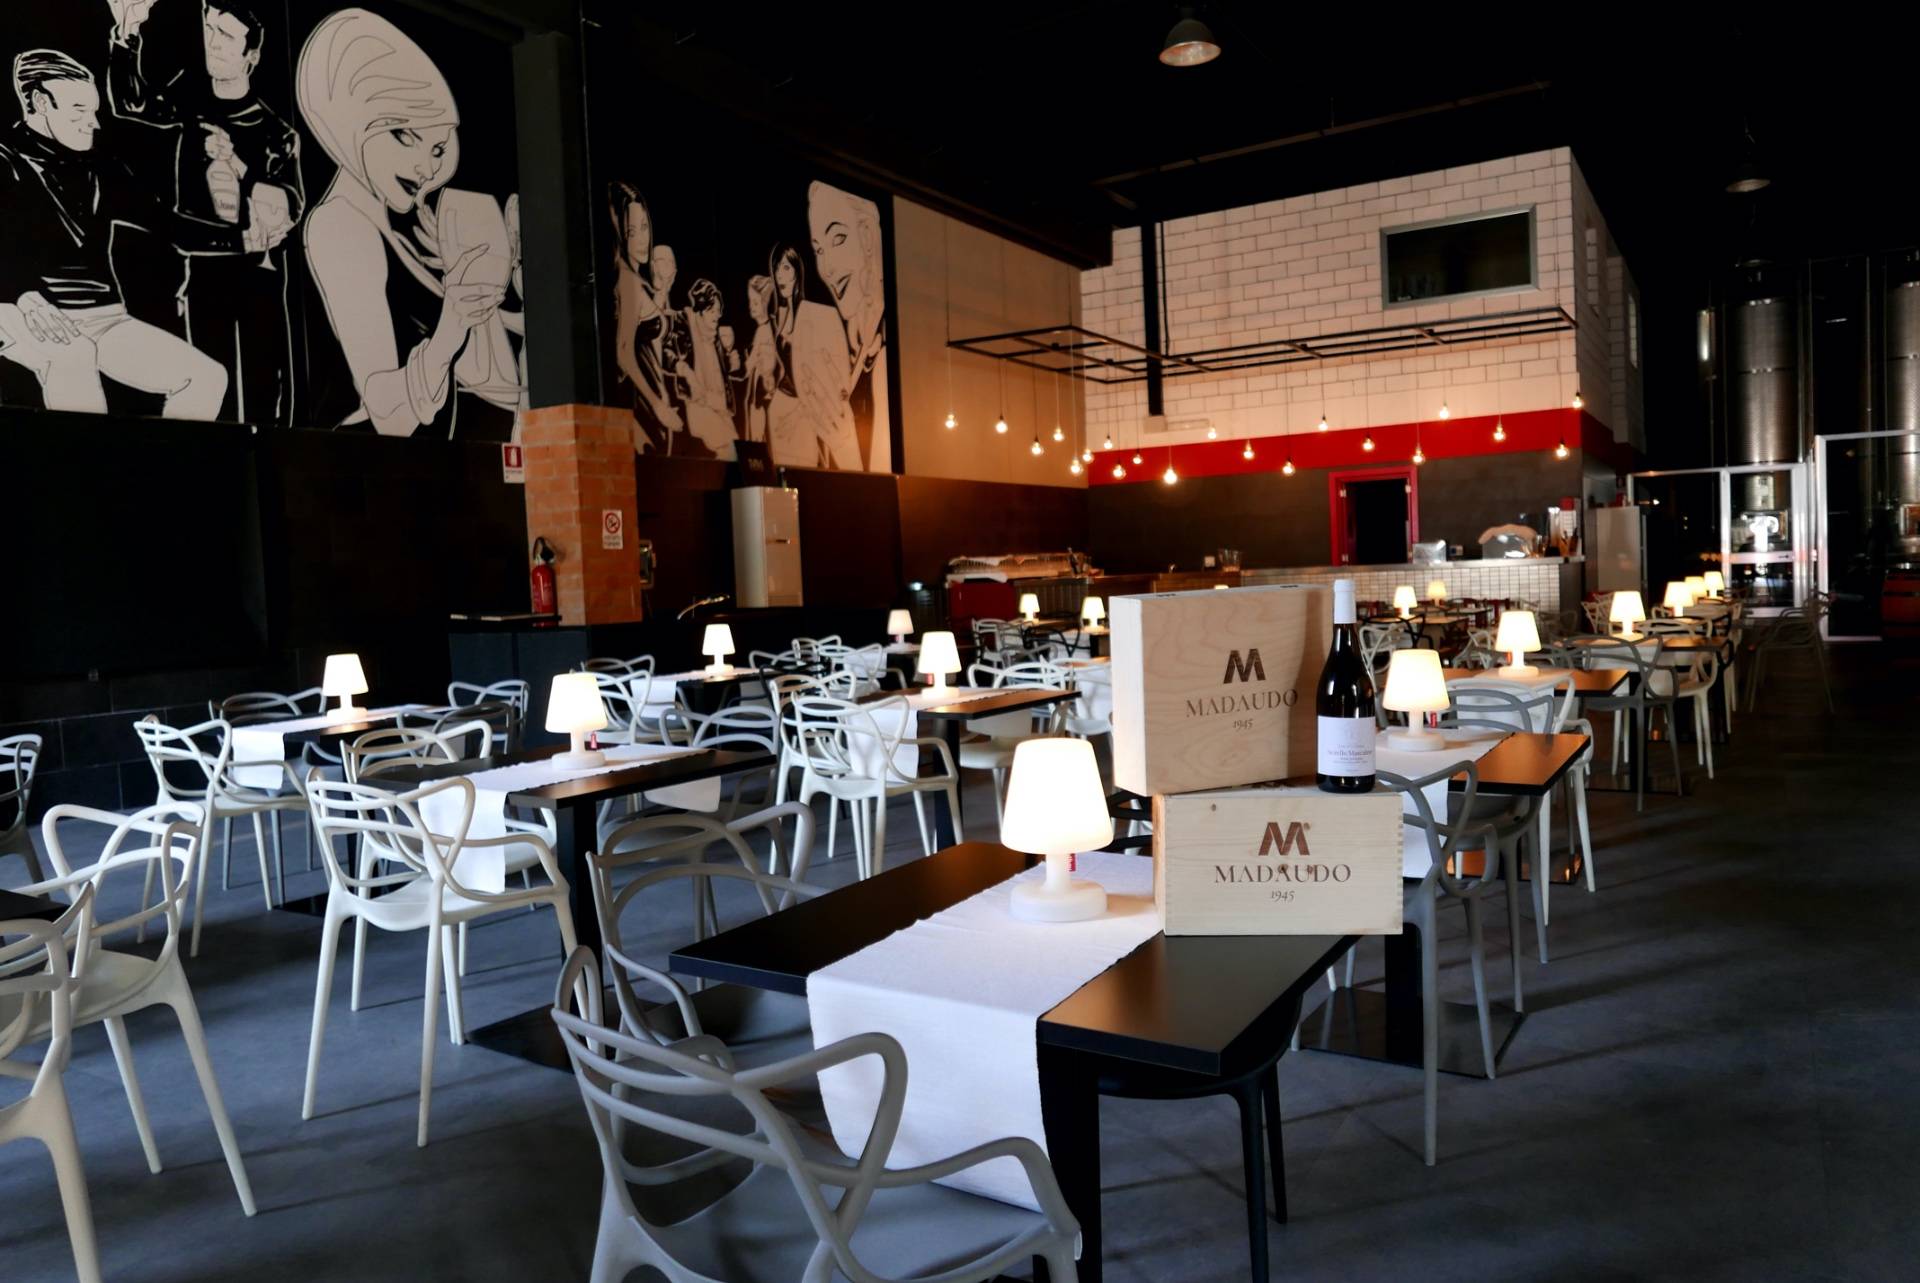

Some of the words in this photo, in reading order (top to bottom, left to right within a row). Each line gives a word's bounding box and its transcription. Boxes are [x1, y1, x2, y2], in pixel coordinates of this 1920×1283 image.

[1223, 648, 1266, 684] M
[1186, 688, 1299, 718] MADAUDO
[1232, 718, 1254, 732] 1945
[1258, 821, 1311, 856] M
[1214, 863, 1352, 884] MADAUDO
[1270, 890, 1296, 903] 1945
